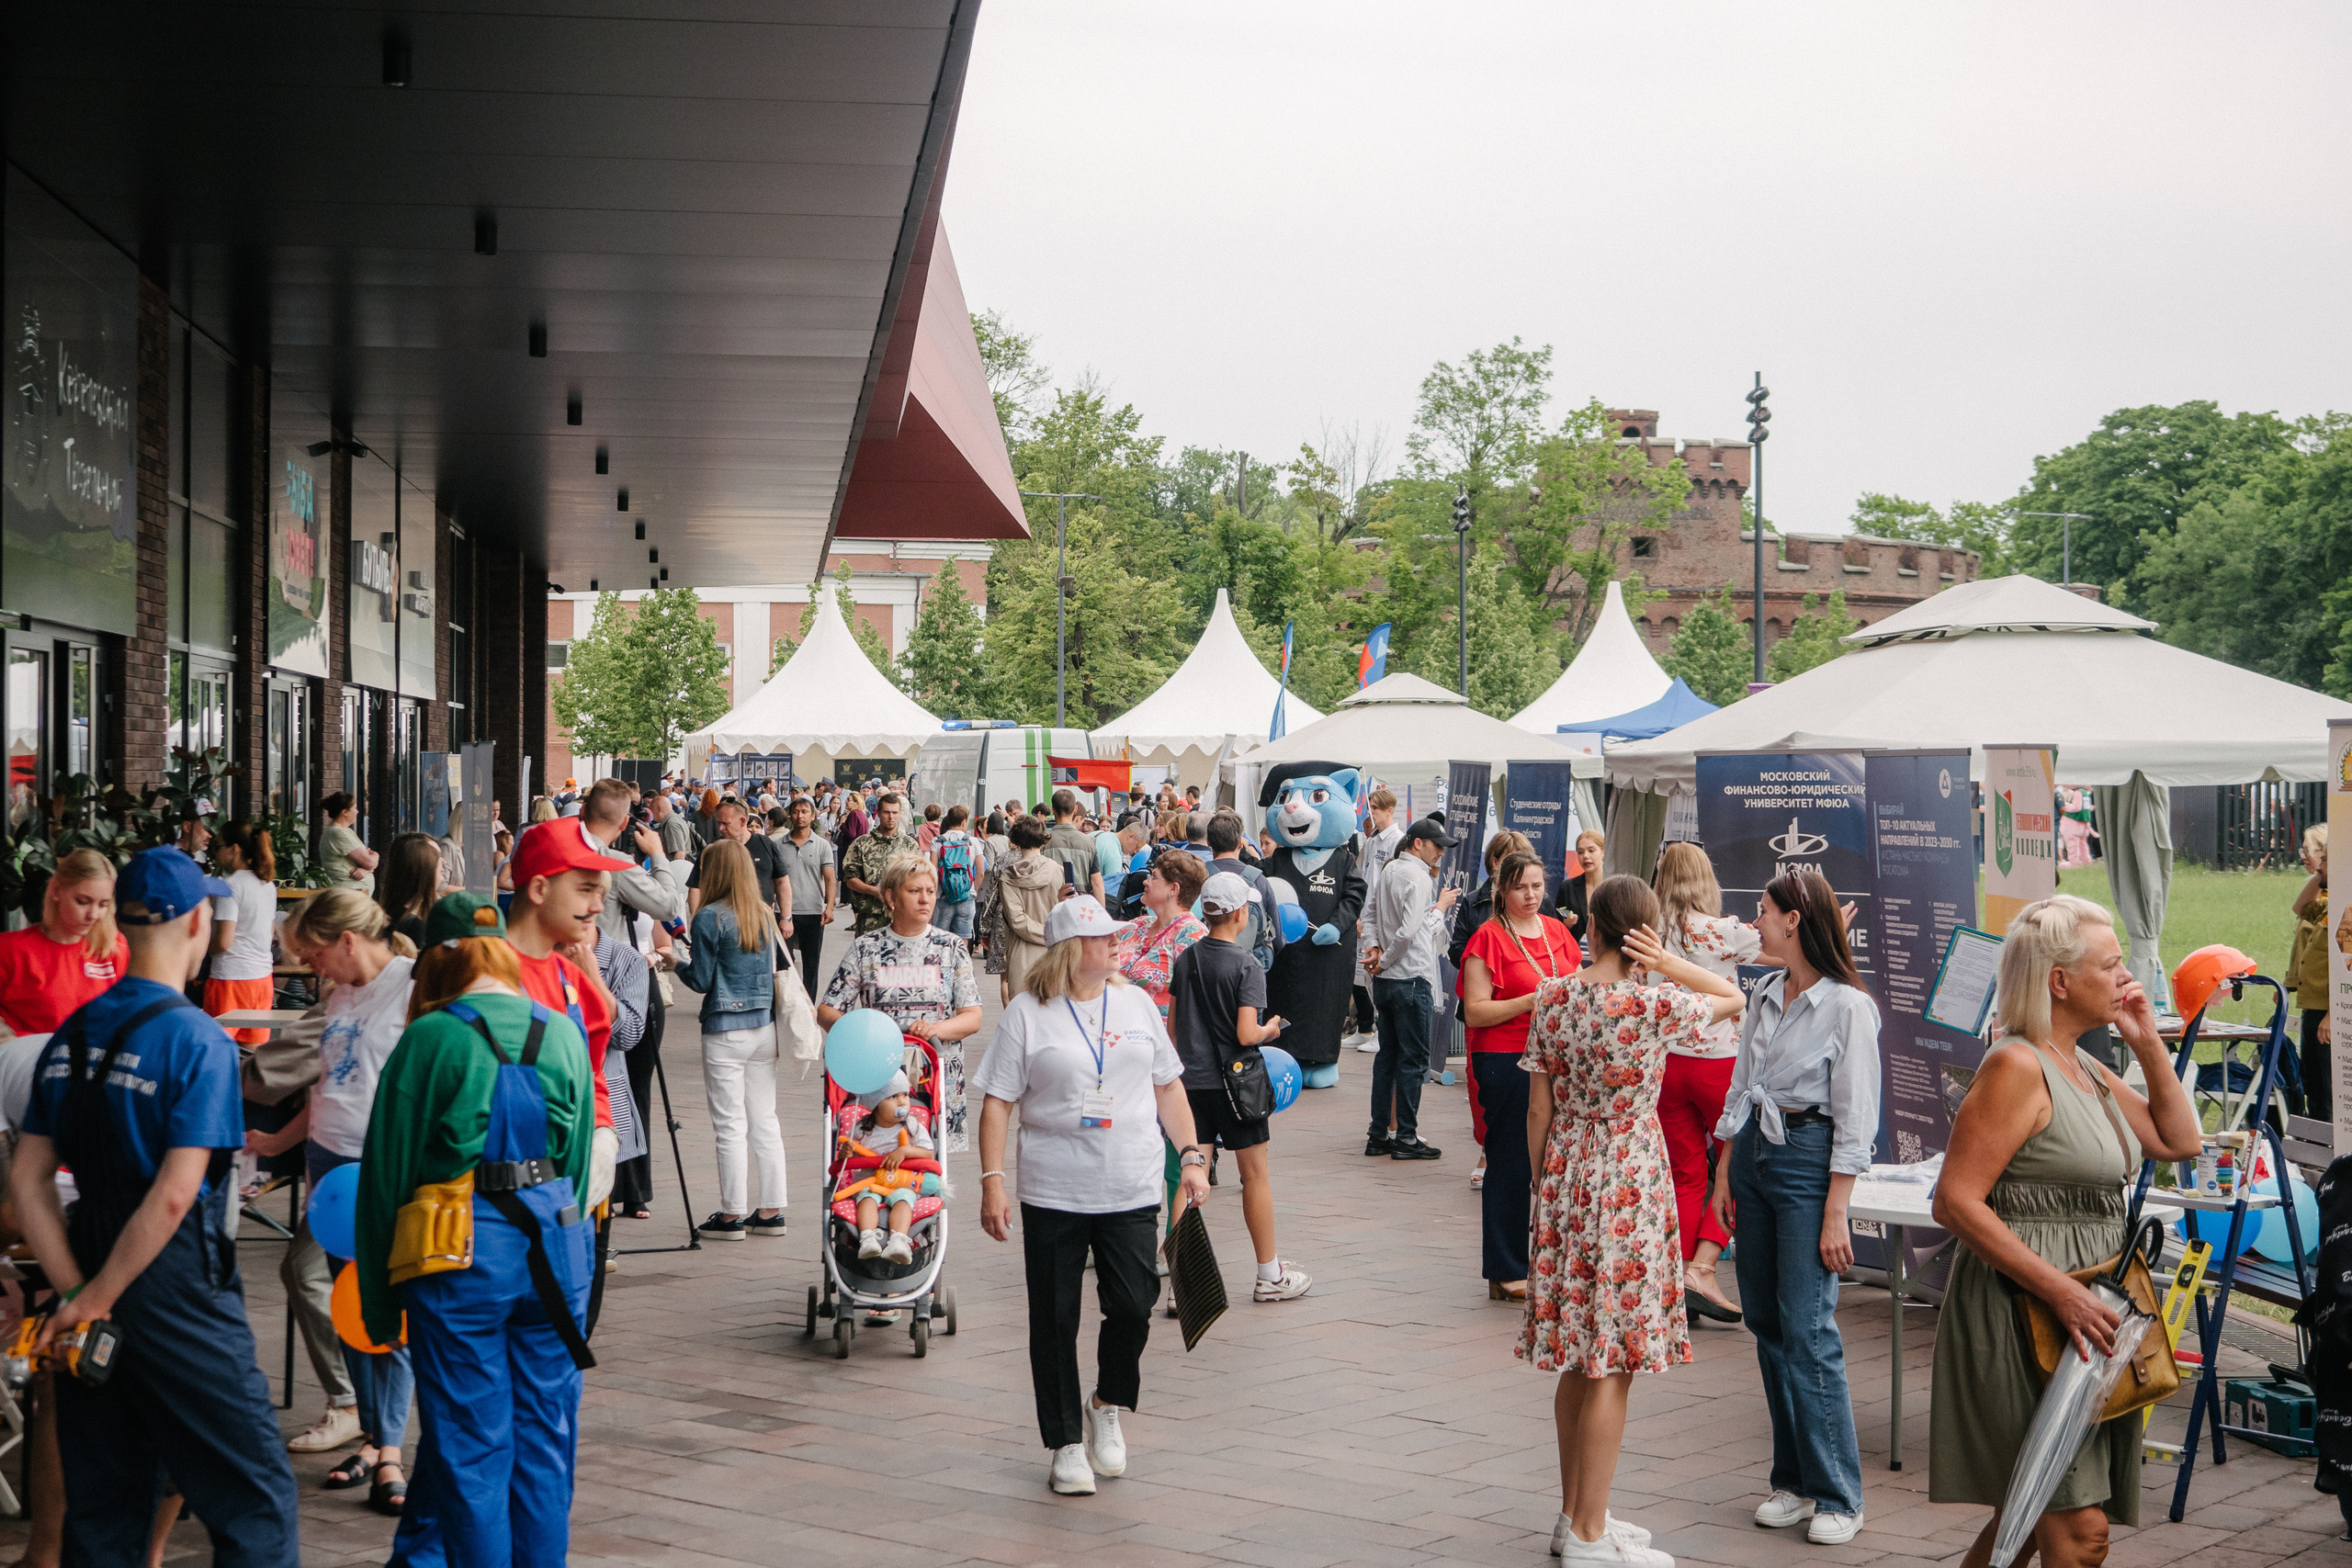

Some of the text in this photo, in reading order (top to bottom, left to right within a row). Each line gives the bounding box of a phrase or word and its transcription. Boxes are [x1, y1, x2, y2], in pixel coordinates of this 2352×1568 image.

[1759, 769, 1830, 782] МОСКОВСКИЙ
[1724, 782, 1866, 796] ФИНАНСОВО-ЮРИДИЧЕСКИЙ
[1510, 797, 1542, 810] Студенческие
[1543, 801, 1562, 812] отряды
[1744, 797, 1849, 808] УНИВЕРСИТЕТ МФЮА
[1878, 803, 1905, 816] ВЫБИРАЙ
[1512, 813, 1555, 826] Калининградской
[1879, 819, 1936, 831] ТОП-10 АКТУАЛЬНЫХ
[1521, 829, 1542, 839] области
[1880, 833, 1919, 847] НАПРАВЛЕНИЙ
[1919, 836, 1924, 847] В
[1925, 836, 1953, 848] 2023-2030
[2016, 837, 2052, 861] КОЛЛЕДЖ
[1775, 863, 1824, 877] МЮА
[1882, 864, 1909, 876] РОСАТОМА
[1309, 885, 1334, 896] МФЮА
[878, 966, 940, 987] MARVEL
